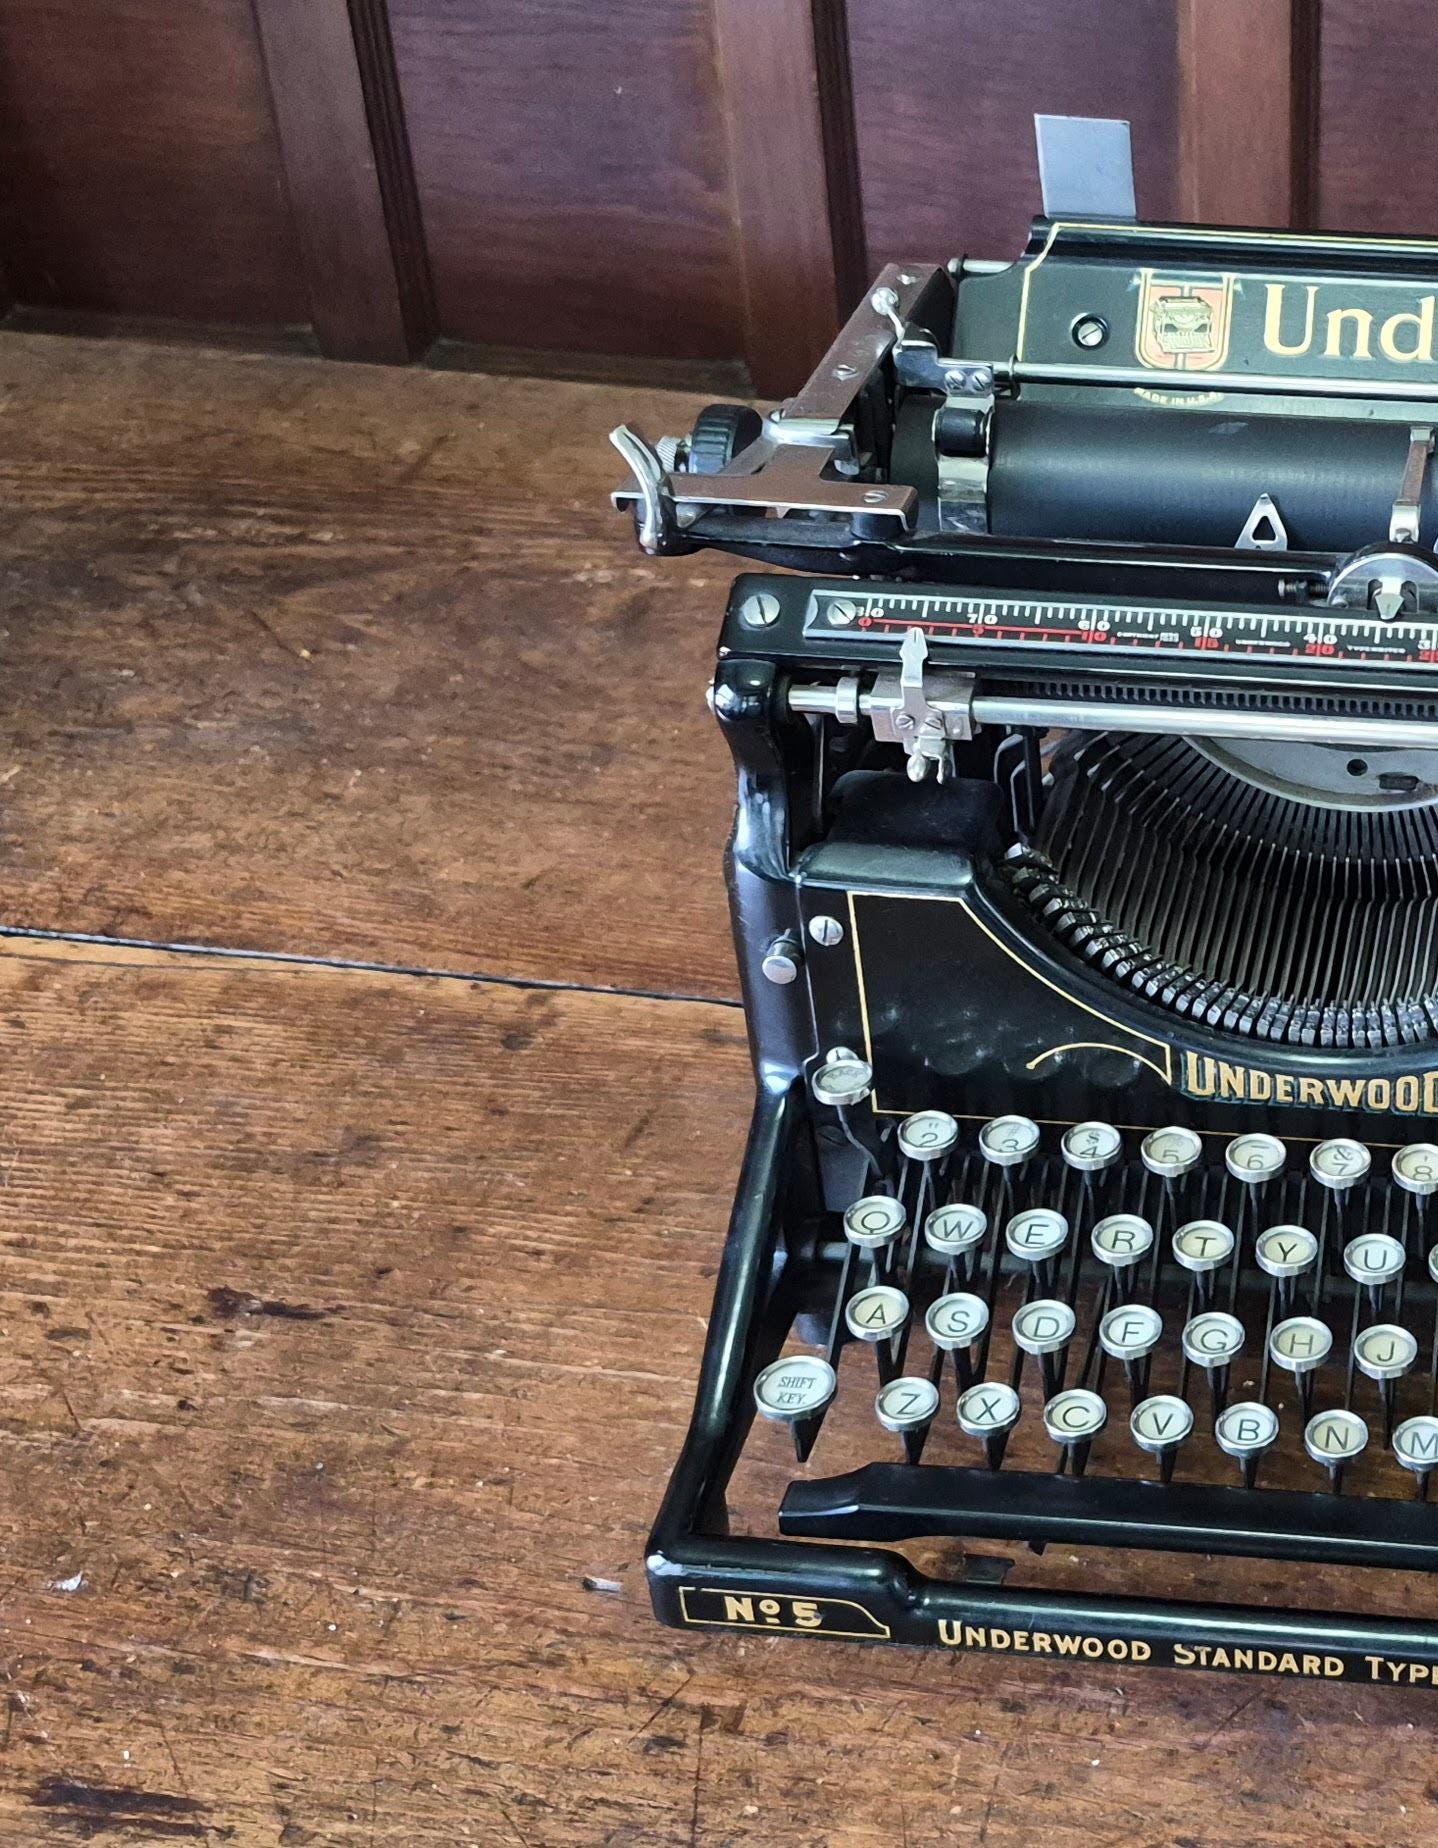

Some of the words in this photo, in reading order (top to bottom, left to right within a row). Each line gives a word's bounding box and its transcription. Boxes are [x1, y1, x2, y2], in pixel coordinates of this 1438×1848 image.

[1133, 387, 1169, 404] MADE
[1171, 396, 1185, 406] IN
[967, 613, 998, 625] 70
[1078, 620, 1110, 632] 60
[1190, 626, 1223, 638] 50
[1303, 633, 1337, 645] 40
[1081, 631, 1107, 642] 10
[1194, 637, 1219, 648] 15
[1305, 643, 1335, 655] 20
[919, 1132, 938, 1147] 2
[1000, 1139, 1020, 1153] 3
[1087, 1131, 1101, 1145] $
[1080, 1146, 1098, 1159] 4
[1162, 1149, 1179, 1163] 5
[1247, 1153, 1264, 1169] 6
[1332, 1146, 1353, 1161] &
[1333, 1162, 1351, 1176] 7
[1412, 1165, 1433, 1181] 8
[860, 1210, 890, 1235] Q
[940, 1218, 973, 1240] W
[1025, 1223, 1049, 1245] E
[1111, 1230, 1136, 1250] R
[1195, 1236, 1217, 1257] T
[1278, 1242, 1298, 1262] Y
[1365, 1249, 1384, 1271] U
[866, 1302, 887, 1325] A
[947, 1309, 969, 1332] S
[1035, 1316, 1060, 1339] D
[1123, 1321, 1145, 1344] F
[1201, 1328, 1227, 1352] G
[1289, 1332, 1314, 1355] H
[1376, 1340, 1396, 1362] J
[778, 1375, 817, 1391] SHIFT
[898, 1393, 922, 1416] Z
[976, 1398, 1002, 1422] X
[1063, 1406, 1091, 1430] C
[1152, 1413, 1173, 1436] V
[1238, 1420, 1260, 1442] B
[1325, 1426, 1350, 1449] N
[792, 1601, 824, 1628] 5
[939, 1618, 1151, 1662] UNDERWOOD
[1174, 1643, 1345, 1678] STANDARD
